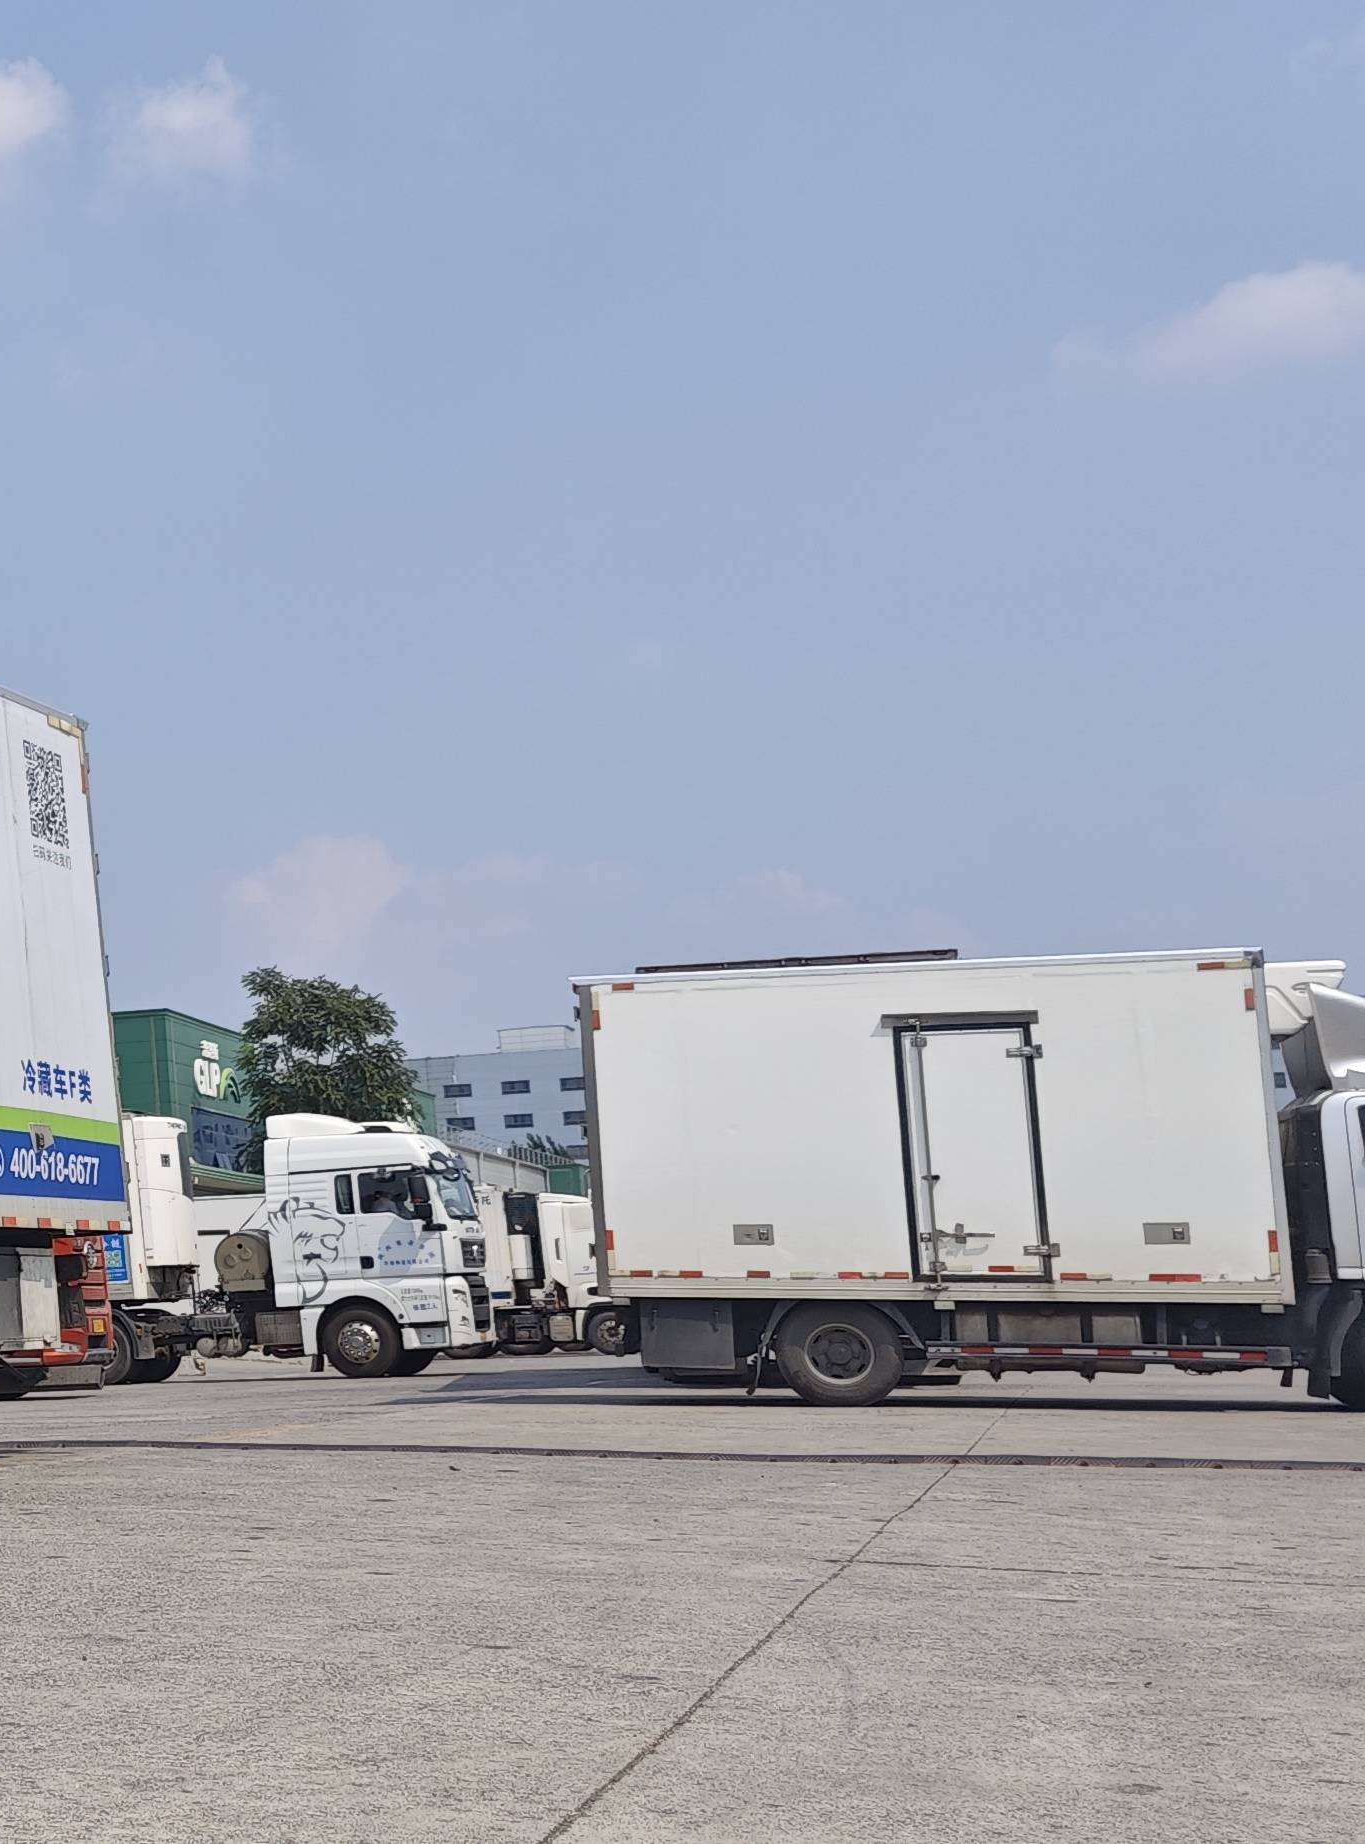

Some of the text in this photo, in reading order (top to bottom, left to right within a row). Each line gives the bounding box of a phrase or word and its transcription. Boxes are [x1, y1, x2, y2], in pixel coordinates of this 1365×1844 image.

[21, 1059, 92, 1104] 冷藏车F类
[194, 1059, 221, 1098] GLP
[10, 1147, 100, 1186] 400-618-6677
